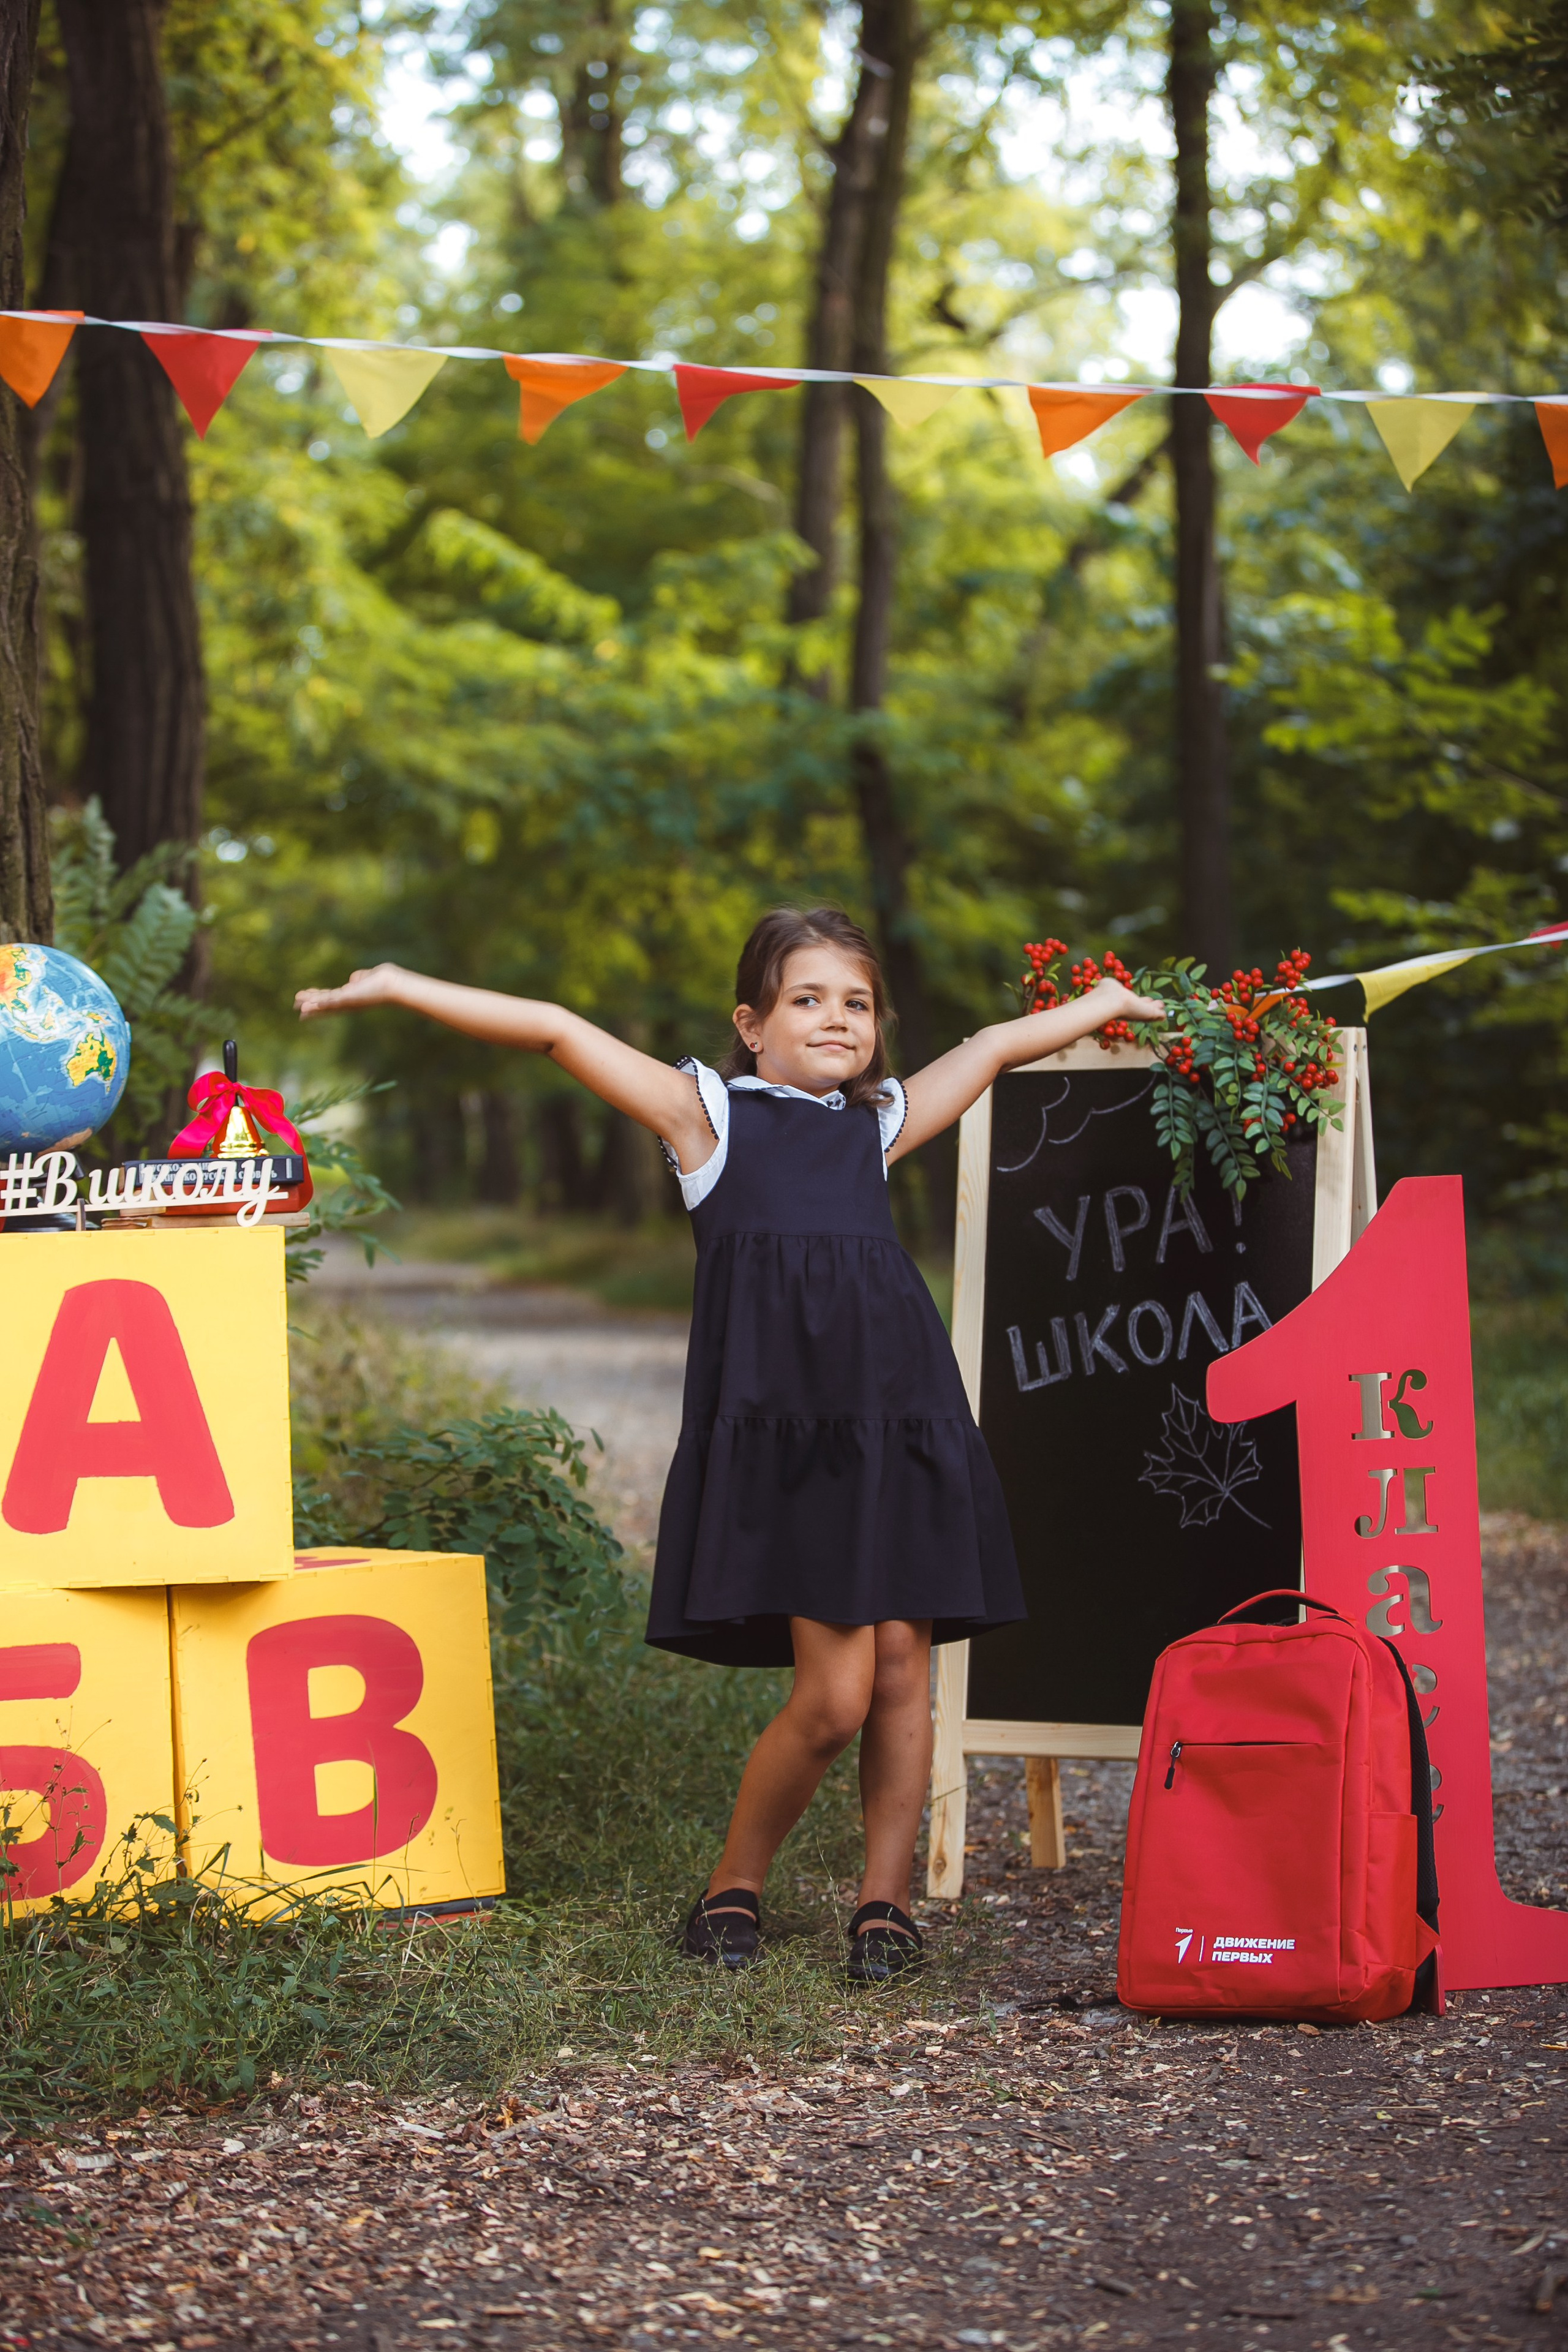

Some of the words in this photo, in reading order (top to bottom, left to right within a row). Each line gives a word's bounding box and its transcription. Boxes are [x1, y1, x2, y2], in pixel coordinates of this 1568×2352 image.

[2, 1279, 235, 1534] А
[1006, 1281, 1273, 1392] ШКОЛА
[1348, 1369, 1444, 1824] кла
[246, 1614, 438, 1867] В
[1212, 1951, 1273, 1964] ПЕРВЫХ
[1213, 1937, 1295, 1950] ДВИЖЕНИЕ
